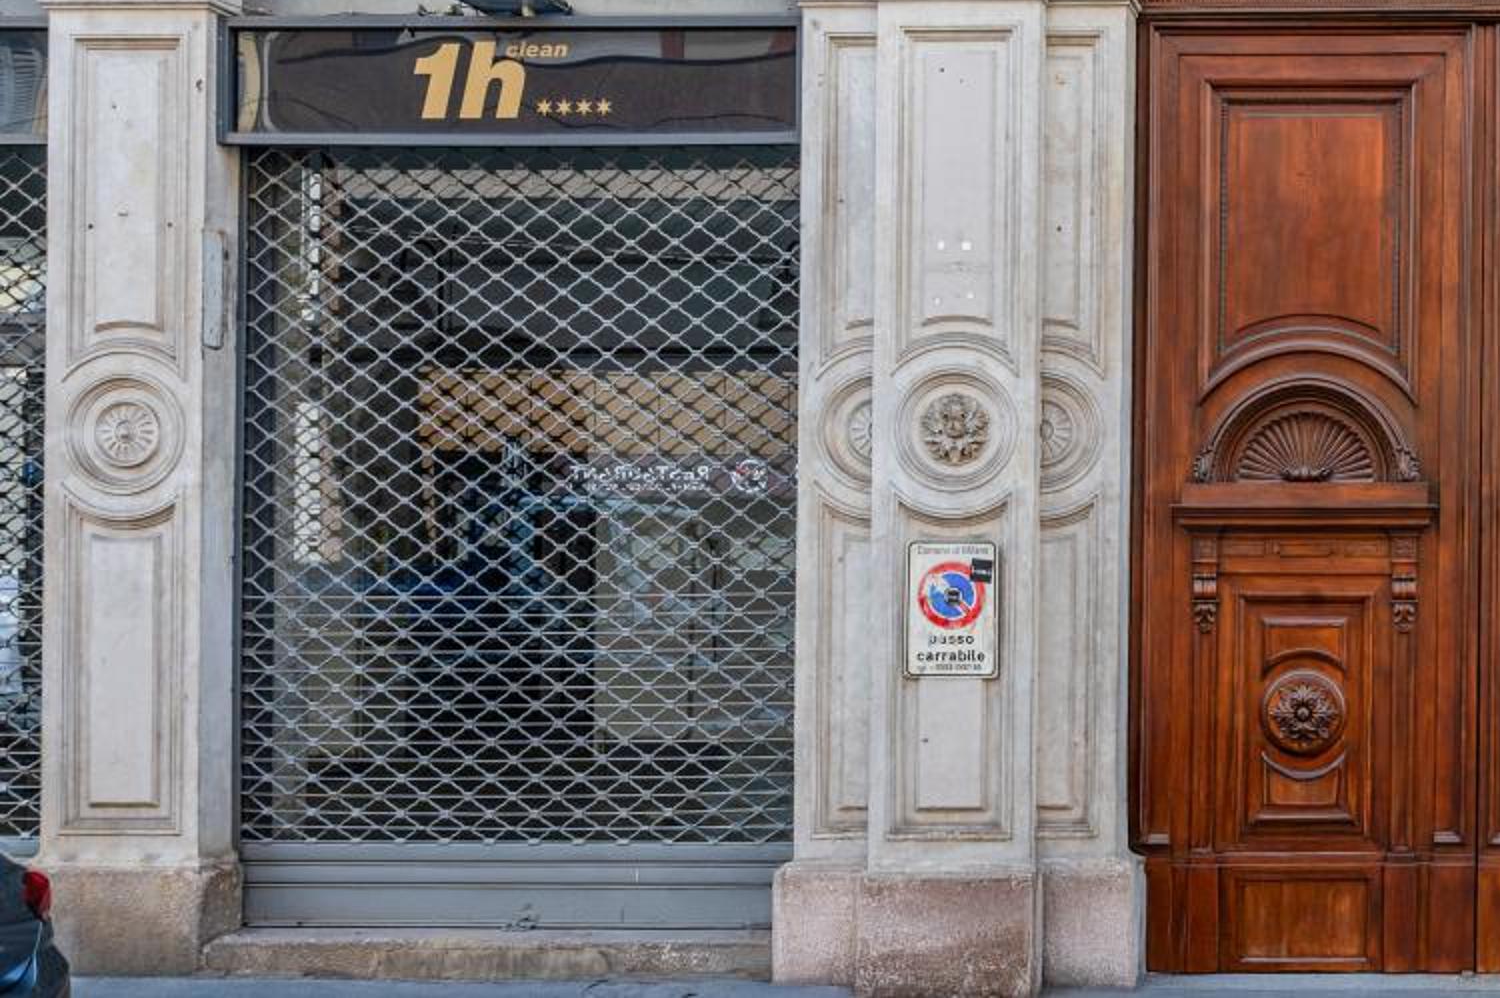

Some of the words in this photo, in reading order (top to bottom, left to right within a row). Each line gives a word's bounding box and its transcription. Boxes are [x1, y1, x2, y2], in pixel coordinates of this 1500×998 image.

[506, 42, 568, 58] clean
[414, 41, 525, 119] 1h
[928, 635, 975, 648] passo
[916, 650, 986, 663] carrabile
